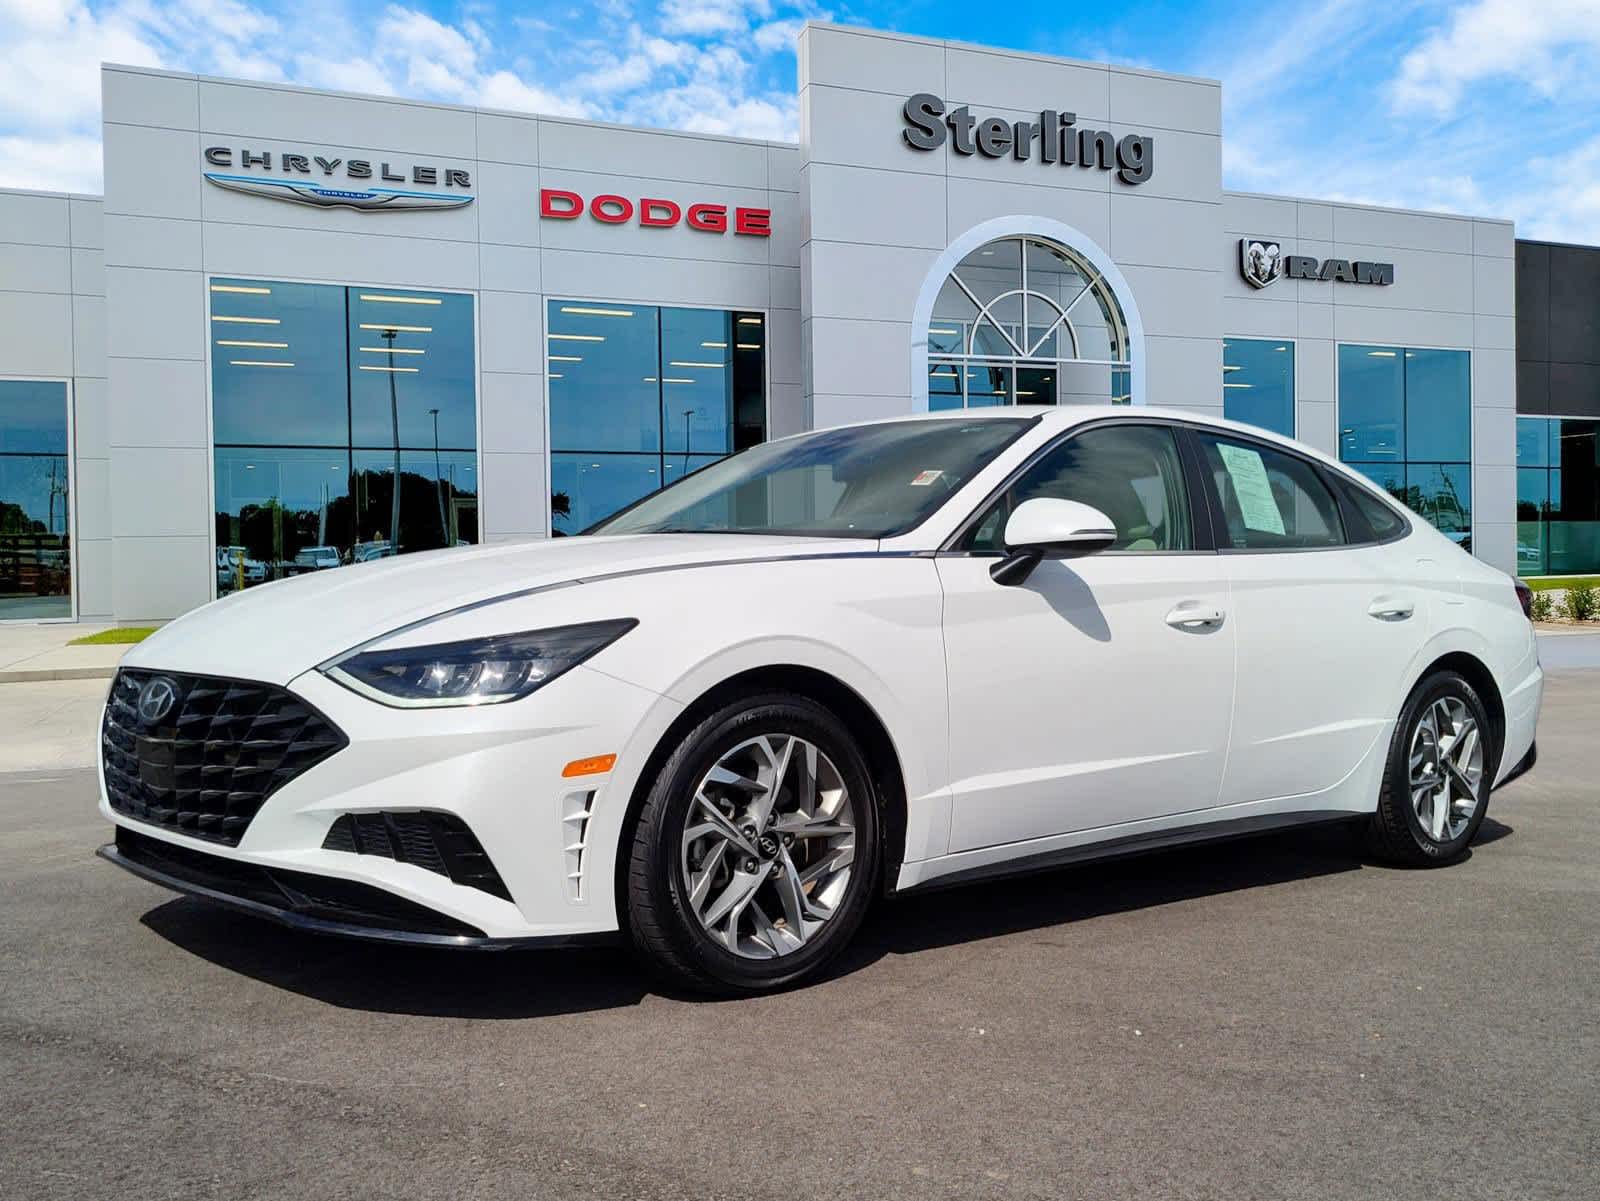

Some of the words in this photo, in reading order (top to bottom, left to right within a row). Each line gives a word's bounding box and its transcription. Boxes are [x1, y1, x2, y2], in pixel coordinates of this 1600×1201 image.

[903, 93, 1153, 184] Sterling
[204, 147, 471, 187] CHRYSLER
[540, 188, 771, 237] DODGE
[1284, 256, 1394, 285] RAM
